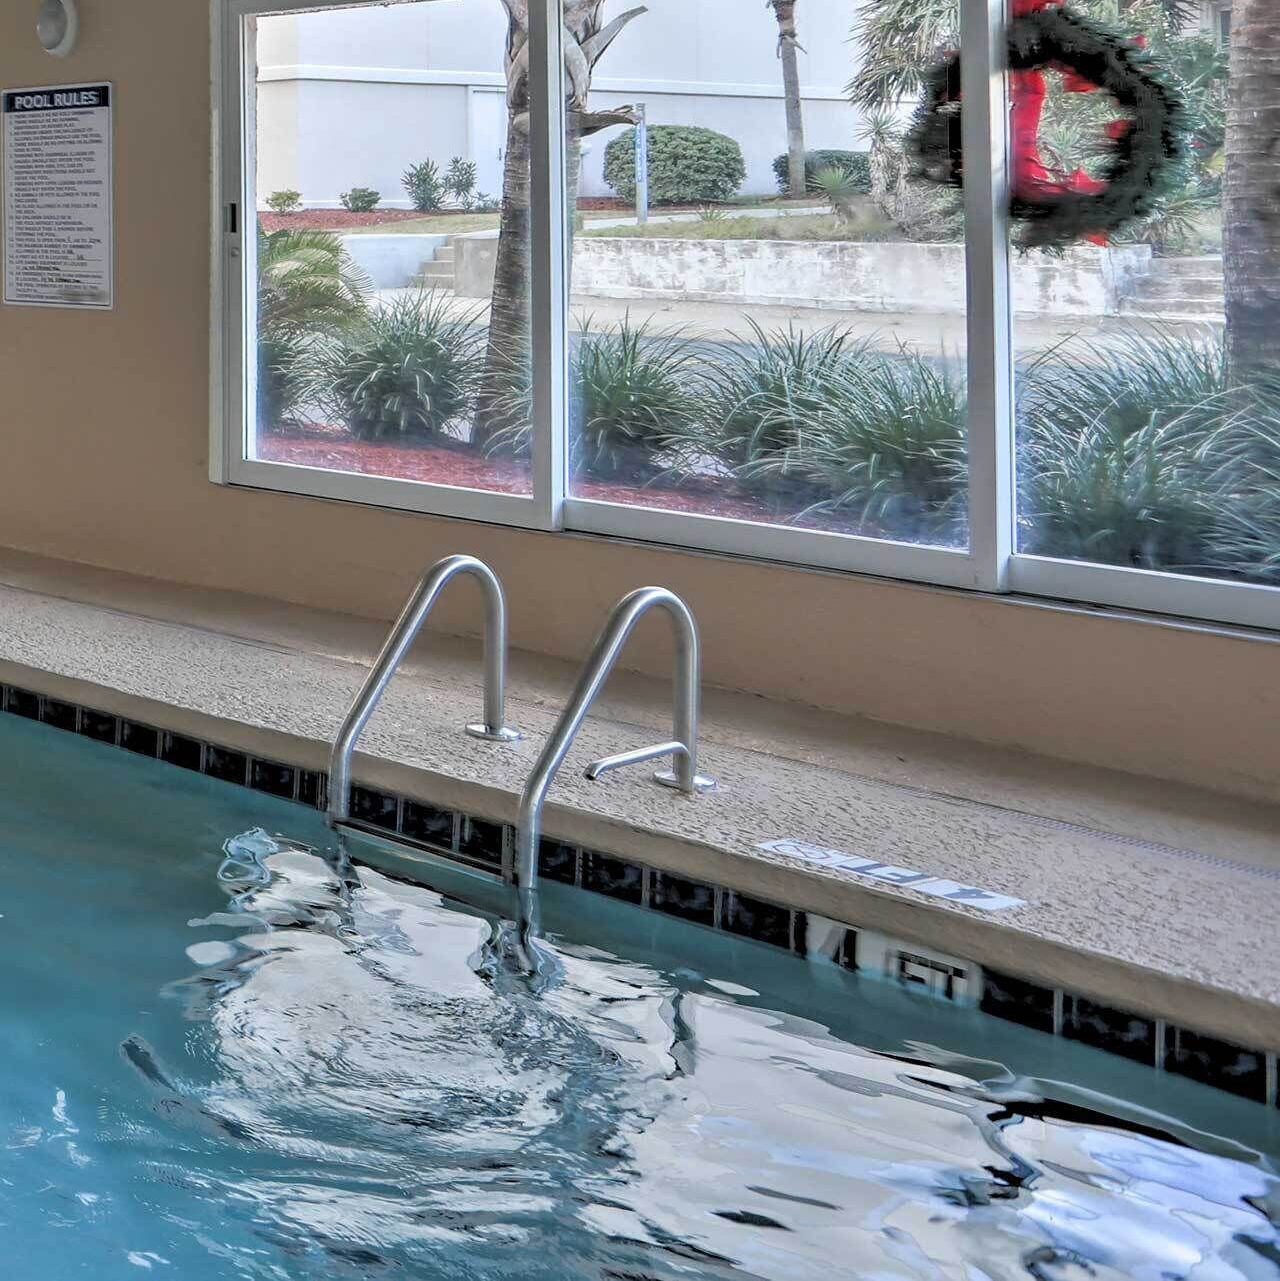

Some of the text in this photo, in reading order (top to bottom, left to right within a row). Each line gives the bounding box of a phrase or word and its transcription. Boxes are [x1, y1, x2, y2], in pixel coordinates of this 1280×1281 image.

[14, 91, 100, 110] POOL RULES
[838, 863, 930, 883] FT
[895, 950, 968, 1000] FT
